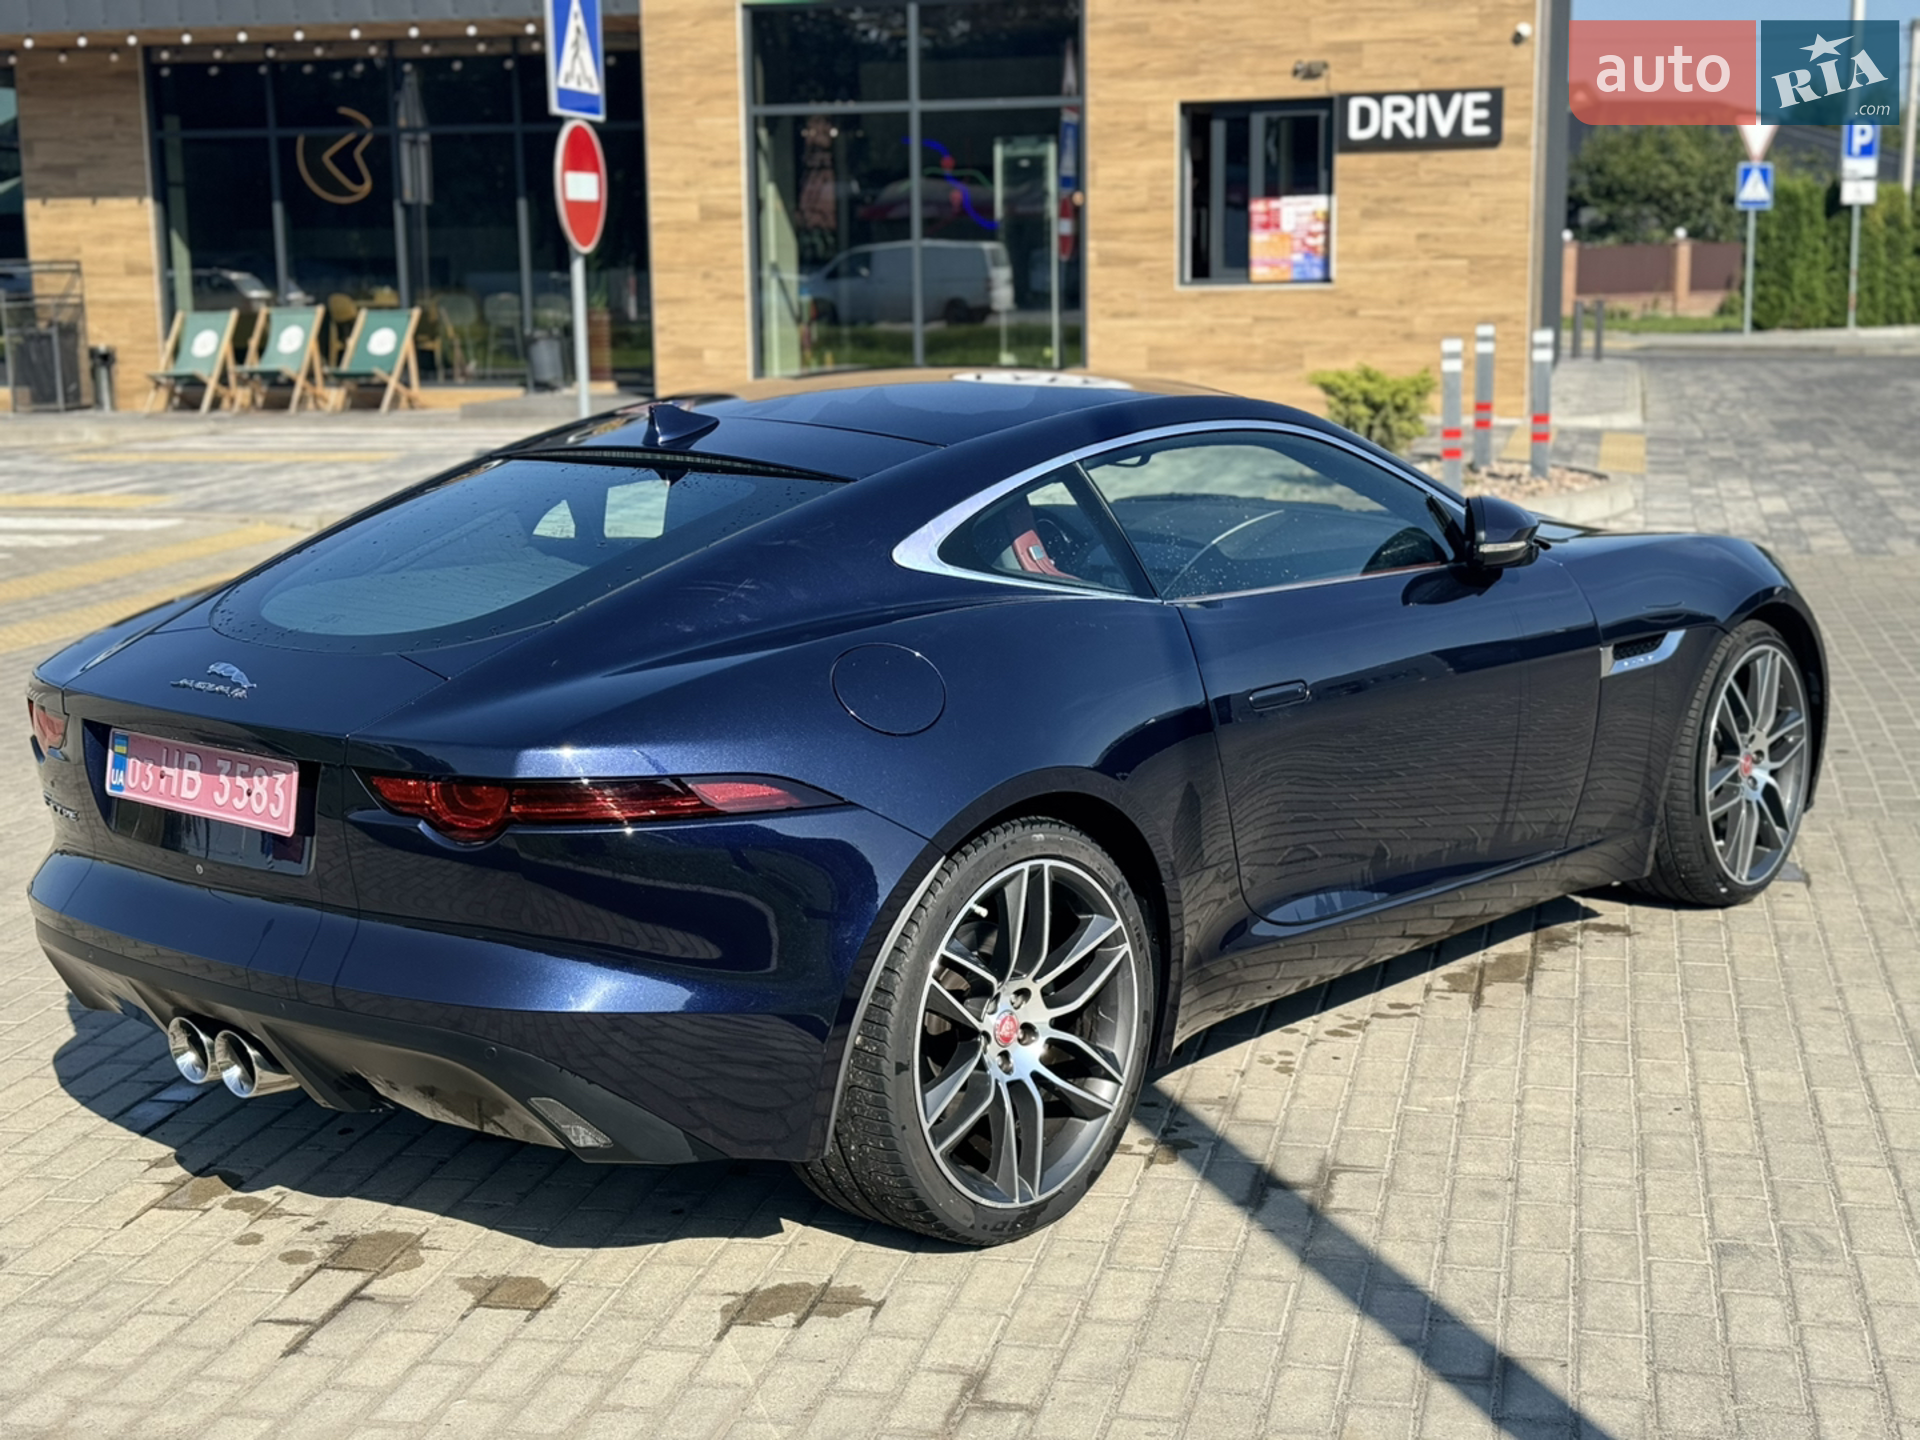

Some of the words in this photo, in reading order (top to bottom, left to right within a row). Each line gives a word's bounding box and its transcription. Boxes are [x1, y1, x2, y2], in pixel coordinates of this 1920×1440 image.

[1348, 92, 1492, 140] DRIVE
[1852, 122, 1874, 157] P
[111, 769, 124, 785] UA
[213, 759, 286, 818] 3583
